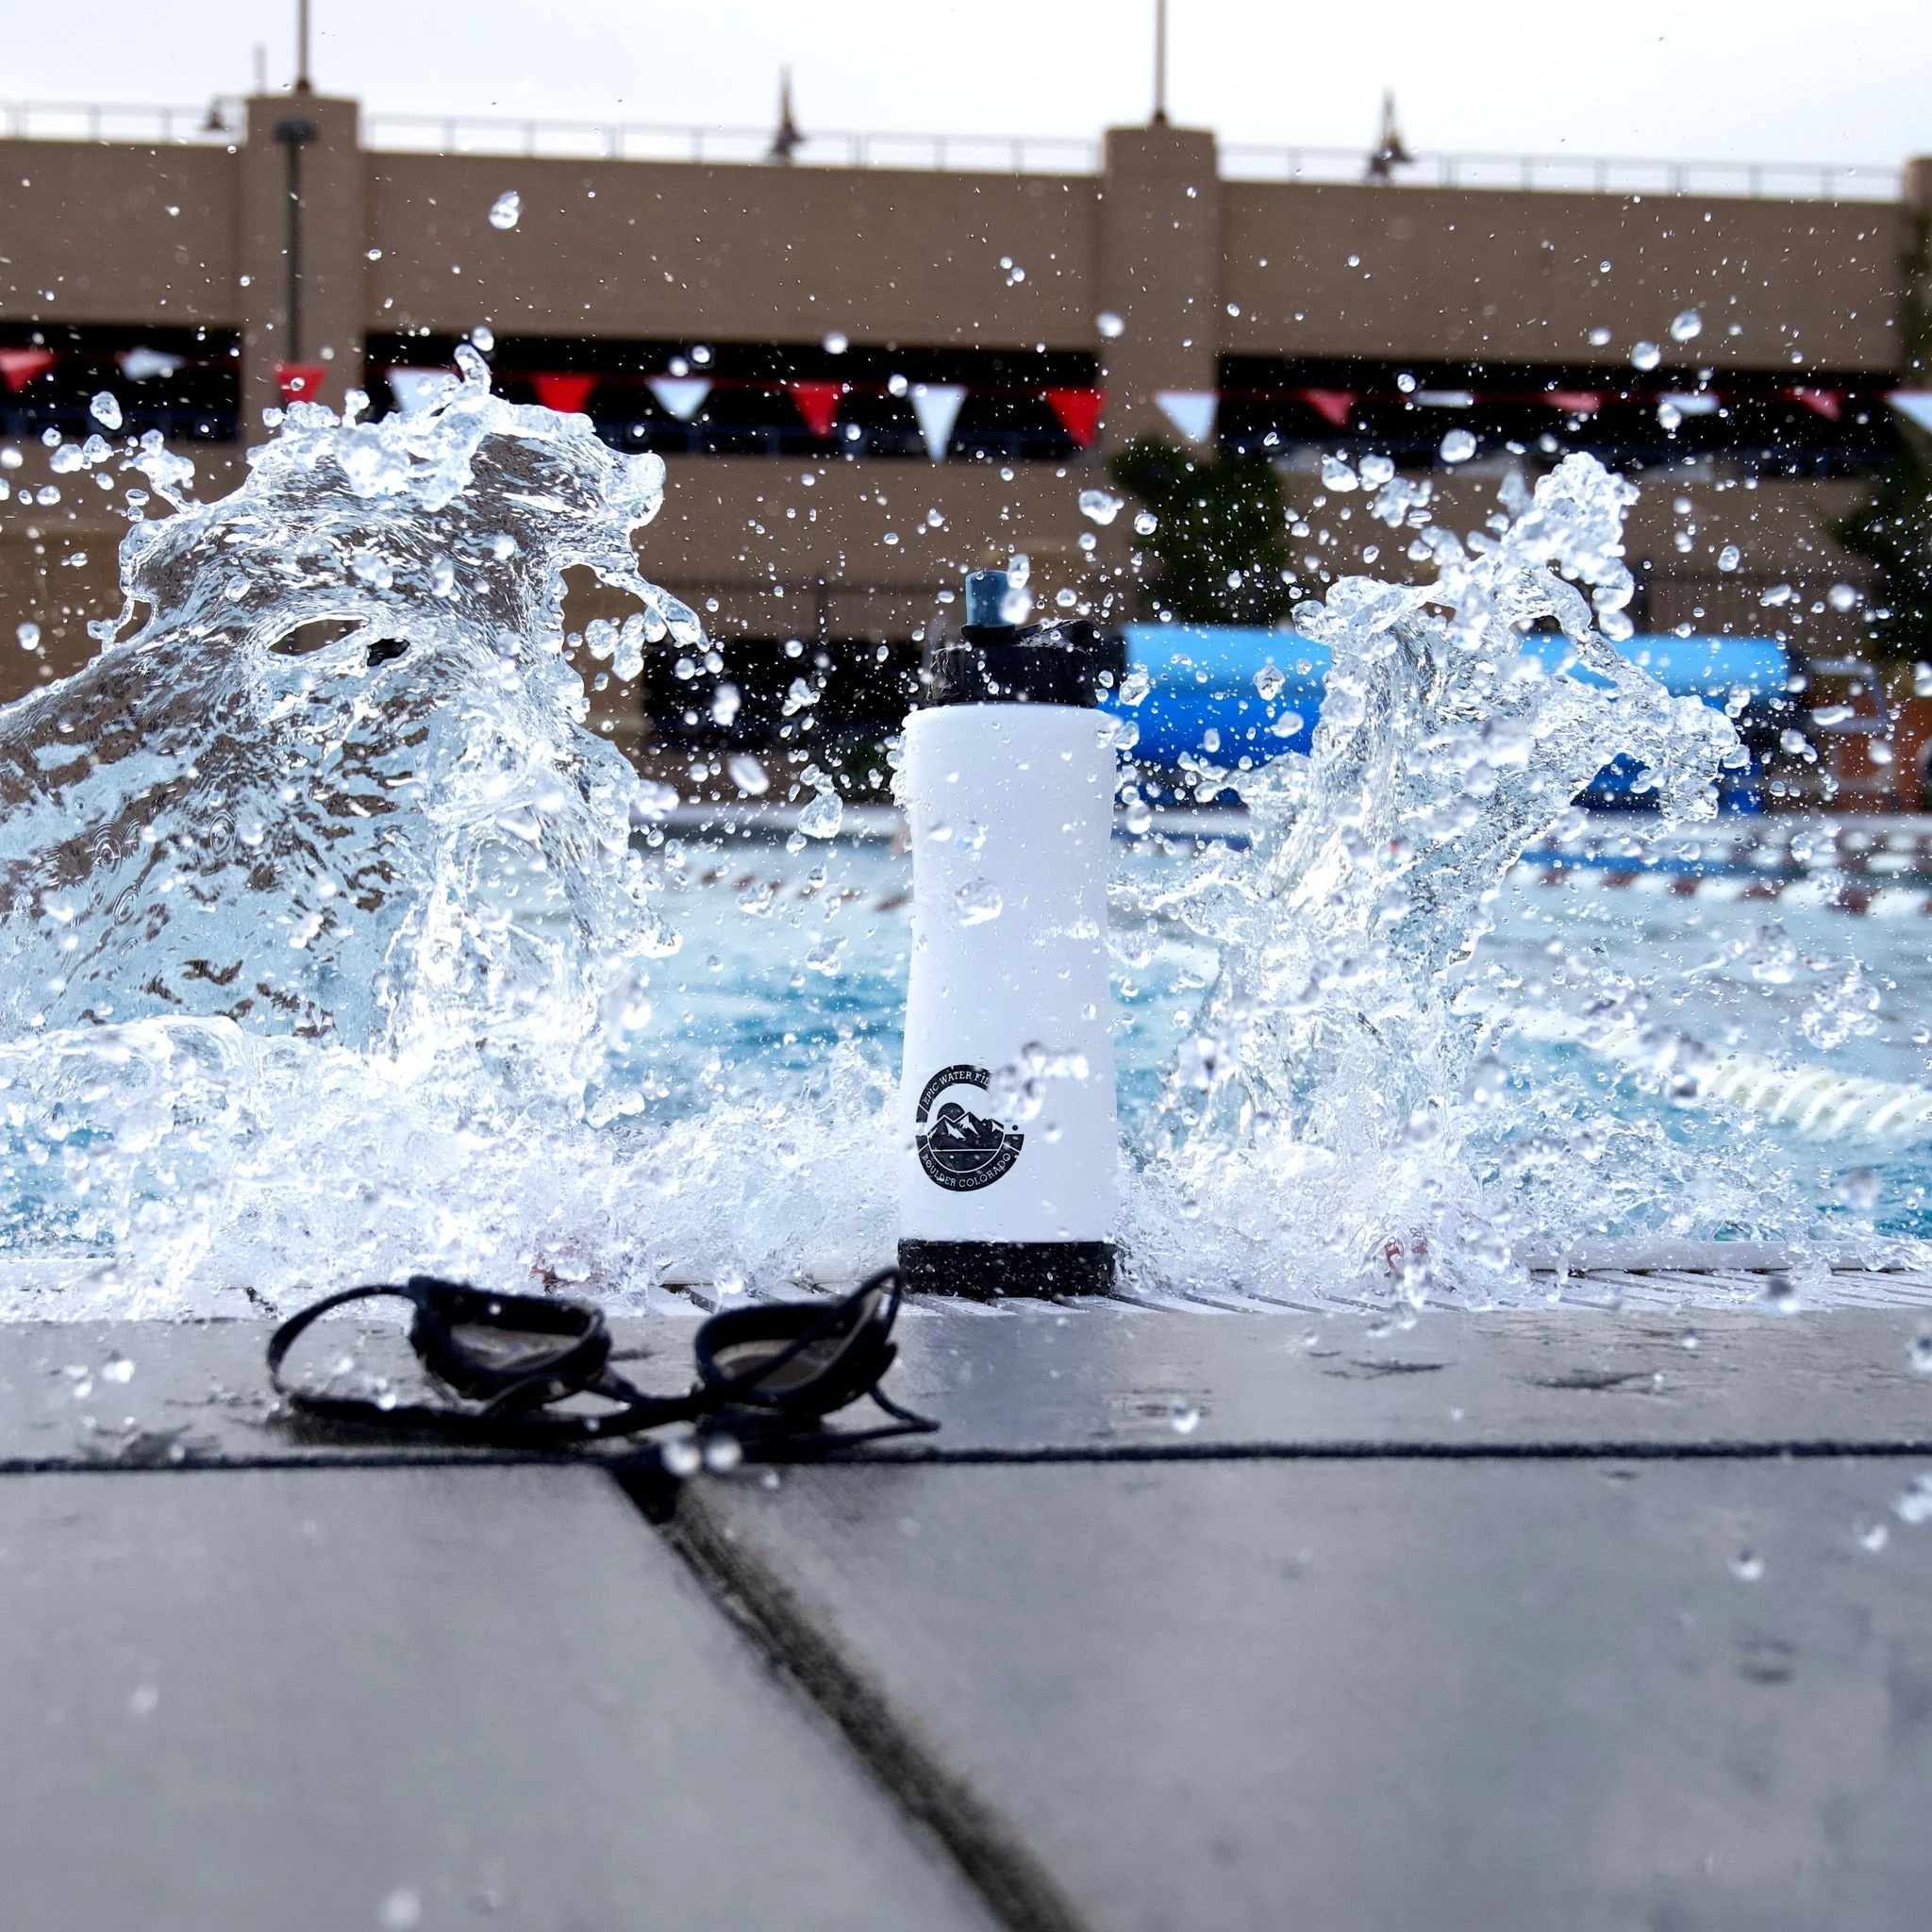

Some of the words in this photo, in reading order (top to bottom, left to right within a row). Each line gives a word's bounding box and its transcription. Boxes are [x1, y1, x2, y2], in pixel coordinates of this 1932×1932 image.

[923, 1082, 939, 1105] EPIC
[939, 1071, 973, 1084] WATER
[922, 1153, 956, 1187] BOULDER
[958, 1152, 1011, 1188] COLORADO
